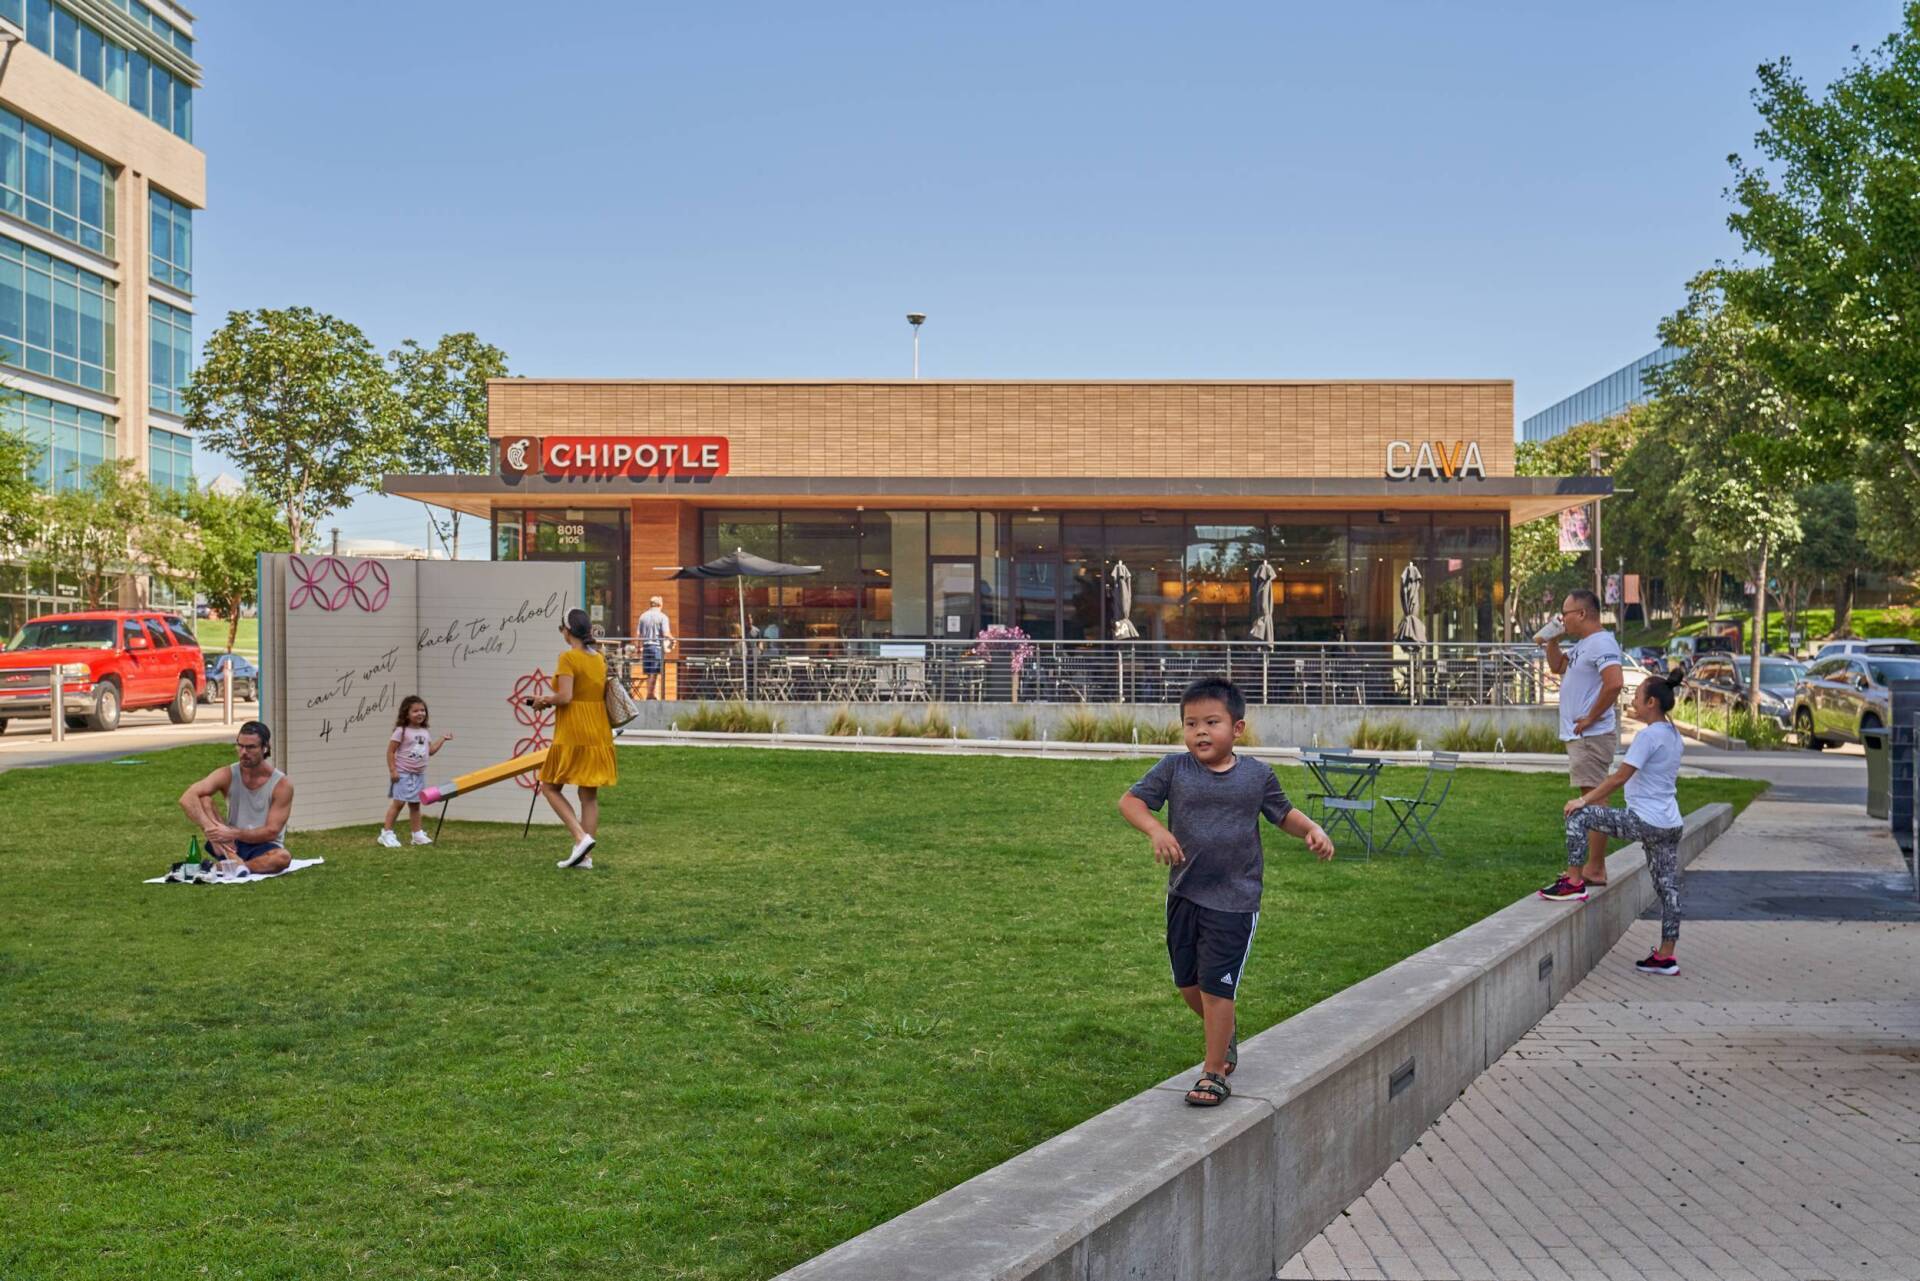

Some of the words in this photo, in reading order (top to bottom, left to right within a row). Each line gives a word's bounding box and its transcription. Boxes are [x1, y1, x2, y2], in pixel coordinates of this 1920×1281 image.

[550, 444, 720, 468] CHIPOTLE
[1386, 441, 1487, 478] CAVA
[557, 525, 584, 535] 8018
[417, 619, 459, 651] back
[465, 618, 489, 640] to
[307, 668, 355, 708] can't
[363, 646, 399, 680] wait
[320, 719, 333, 743] 4
